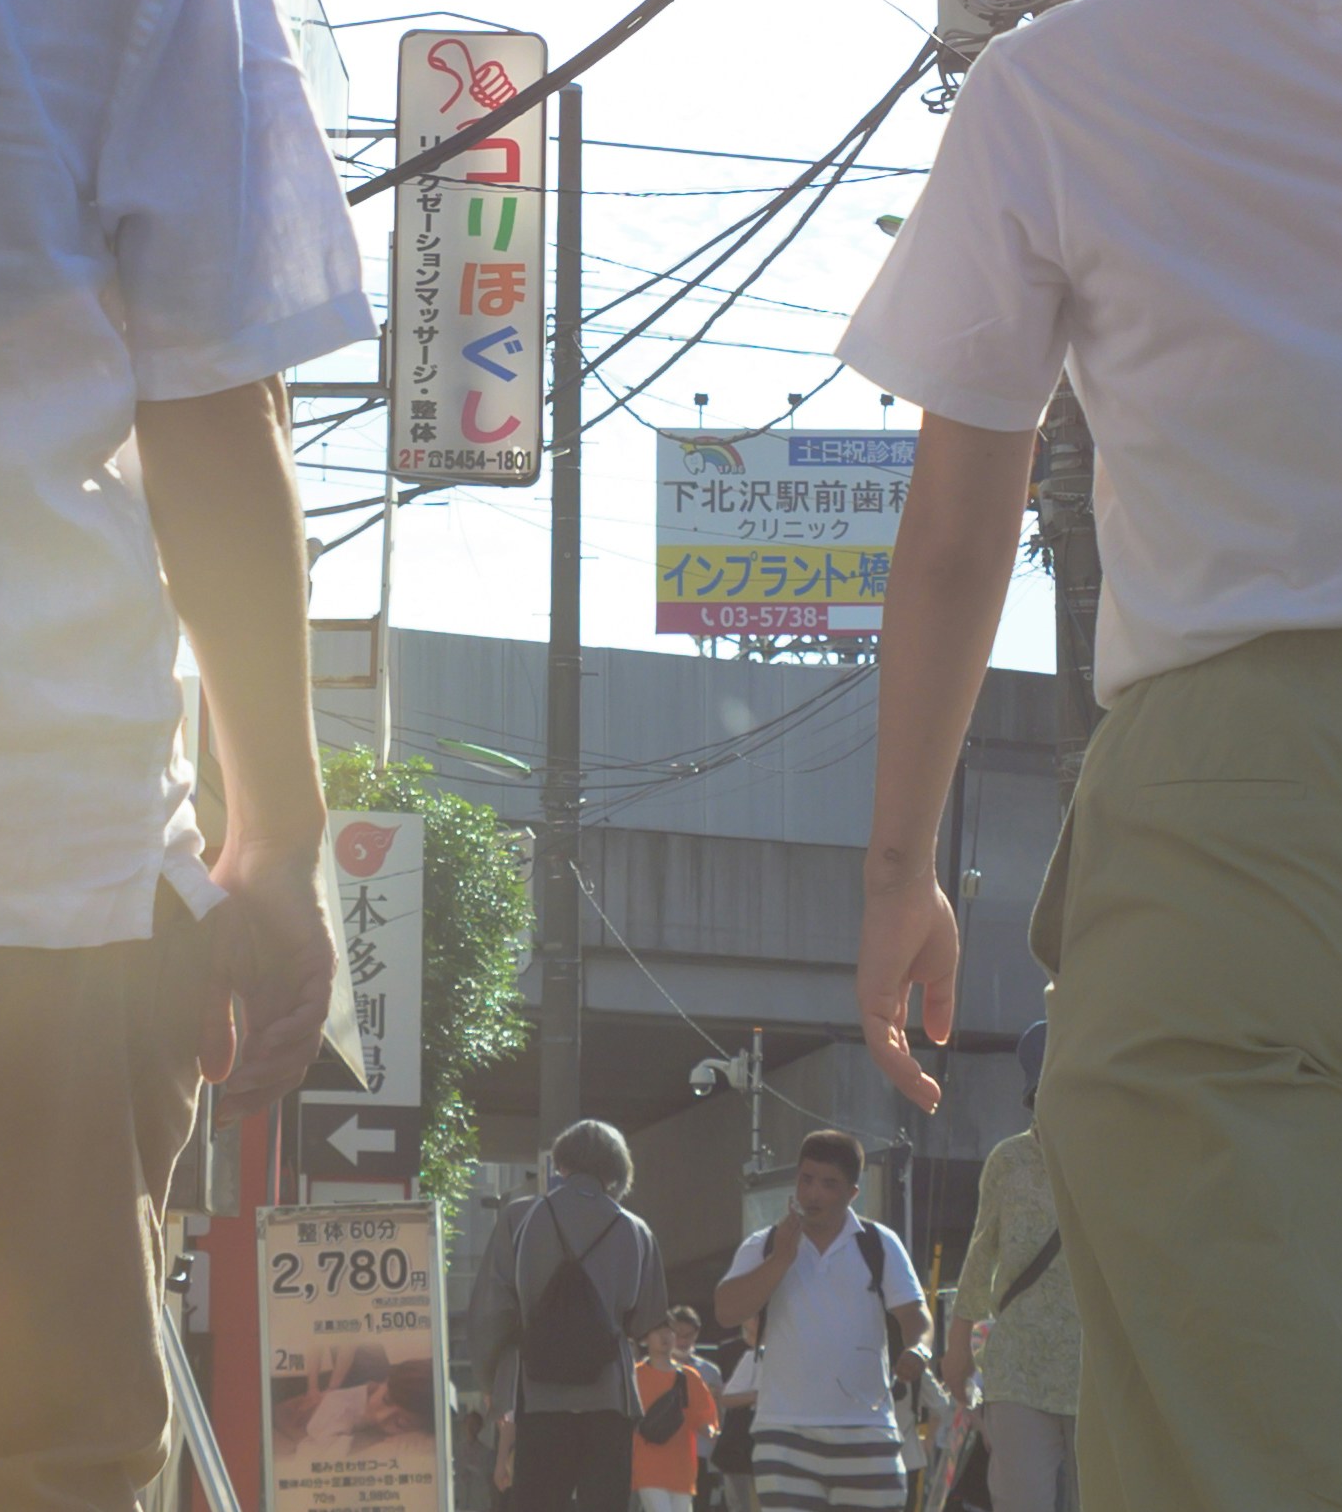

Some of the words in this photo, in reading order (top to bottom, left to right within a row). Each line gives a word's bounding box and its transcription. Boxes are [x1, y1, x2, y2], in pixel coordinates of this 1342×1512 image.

[409, 135, 443, 444] リクゼーションマッサージ・整体
[458, 136, 527, 445] コリほぐし
[398, 448, 426, 469] 2F
[444, 449, 533, 471] 5454-1801
[797, 440, 915, 464] 土日祝診療
[737, 518, 851, 540] クリニック
[274, 1348, 306, 1371] 2階
